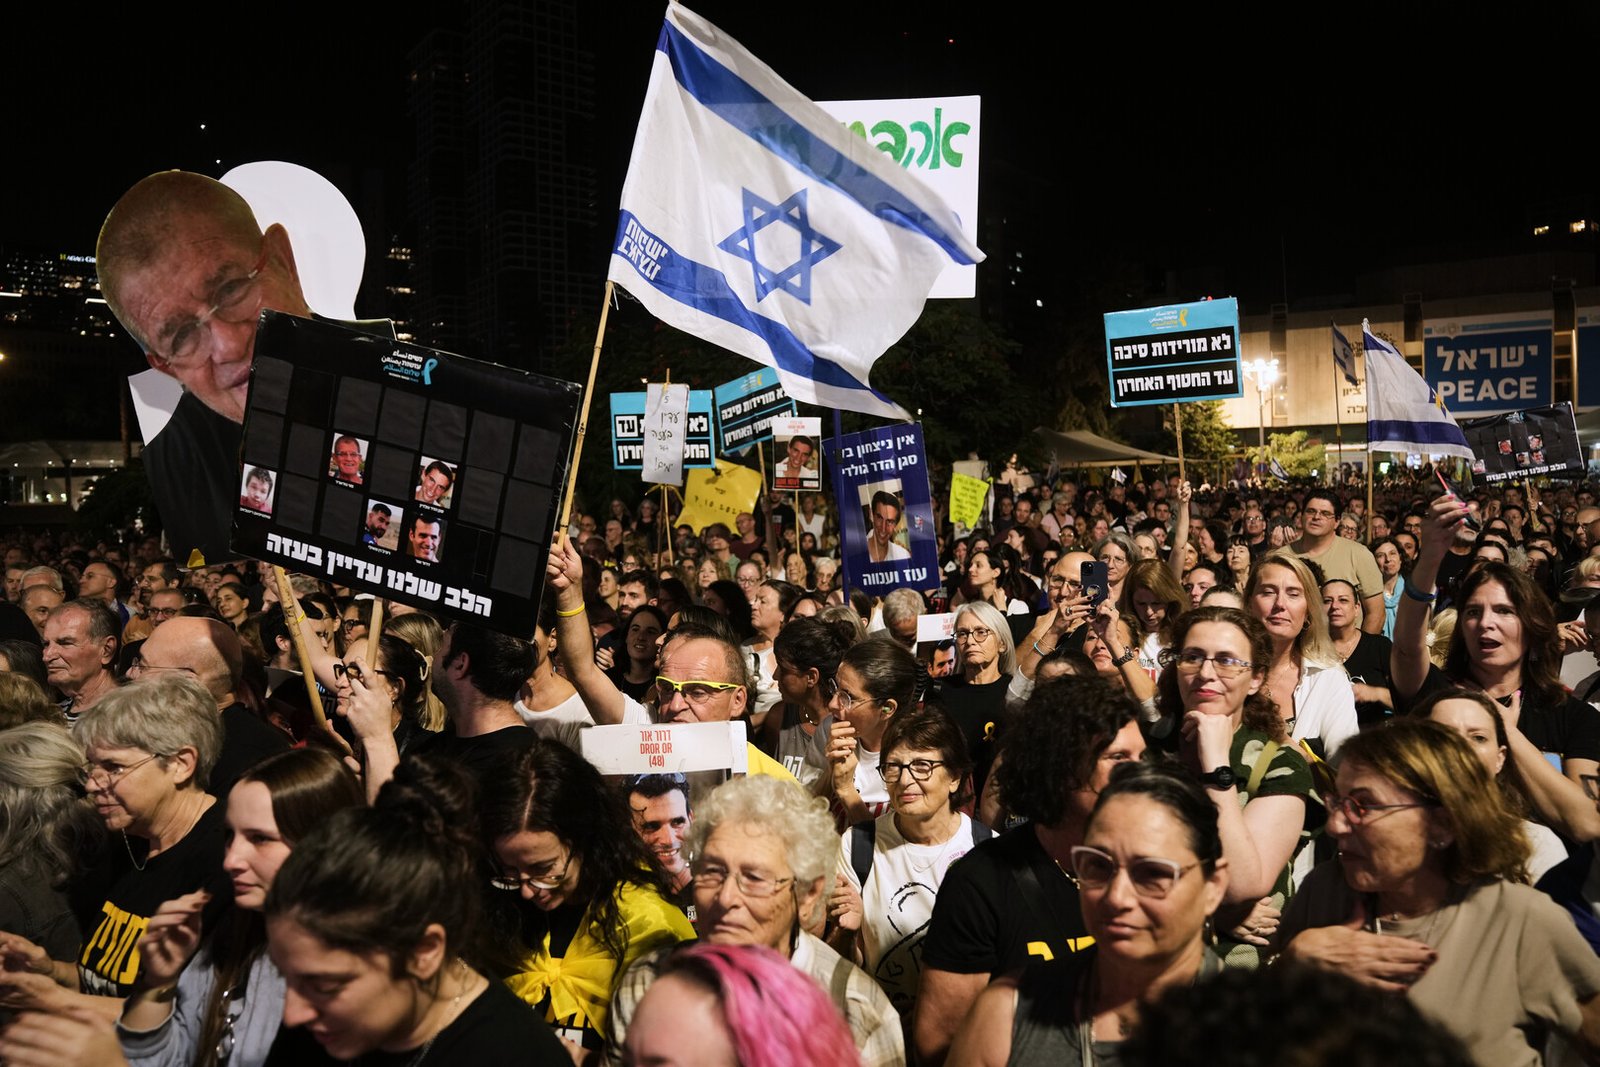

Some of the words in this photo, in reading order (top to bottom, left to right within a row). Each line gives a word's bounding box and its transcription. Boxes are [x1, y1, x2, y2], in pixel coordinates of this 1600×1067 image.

[1151, 337, 1208, 357] מורידות
[1211, 333, 1232, 351] לא
[1437, 344, 1539, 372] ישראל
[1116, 375, 1164, 397] האחרון
[1166, 371, 1211, 391] החטוף
[1213, 369, 1234, 385] עד
[1437, 376, 1538, 404] PEACE
[618, 419, 636, 433] עד
[689, 415, 708, 432] לא
[856, 439, 893, 459] ניצחון
[896, 433, 916, 450] אין
[870, 459, 895, 472] הדר
[898, 454, 918, 471] סגן
[266, 532, 323, 567] בעזה
[326, 549, 384, 585] עדיין
[387, 567, 442, 601] שלנו
[445, 584, 493, 617] הלב
[639, 731, 653, 742] אור
[654, 729, 672, 741] דרור
[640, 743, 661, 755] DROR
[661, 742, 673, 754] OR
[648, 754, 665, 768] (48)
